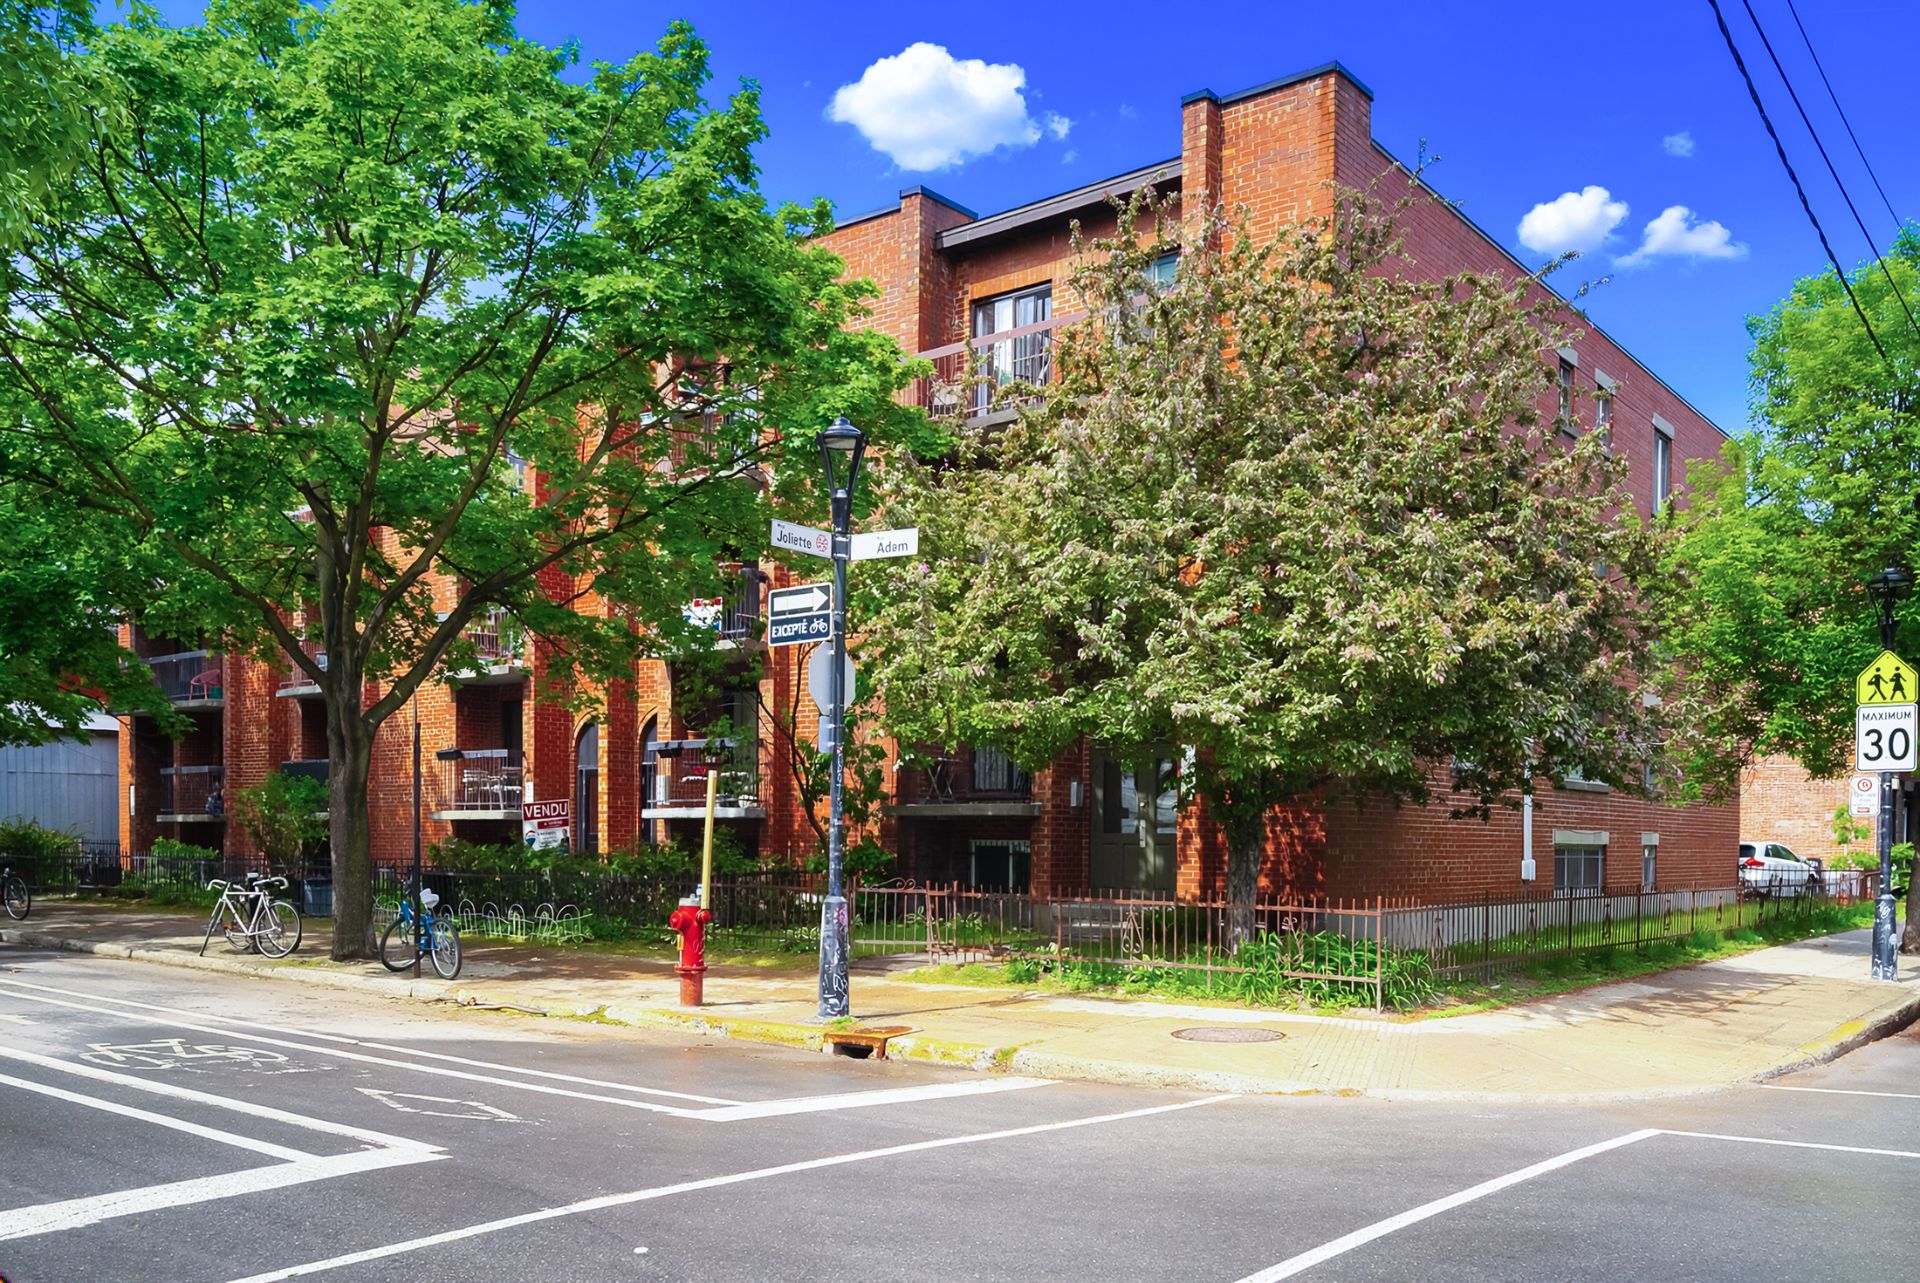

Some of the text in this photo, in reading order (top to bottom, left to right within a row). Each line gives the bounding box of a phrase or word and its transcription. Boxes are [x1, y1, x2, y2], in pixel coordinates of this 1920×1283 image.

[777, 529, 812, 549] Joliette
[1862, 711, 1912, 722] MAXIMUM
[1863, 728, 1910, 761] 30
[524, 803, 568, 818] VENDU
